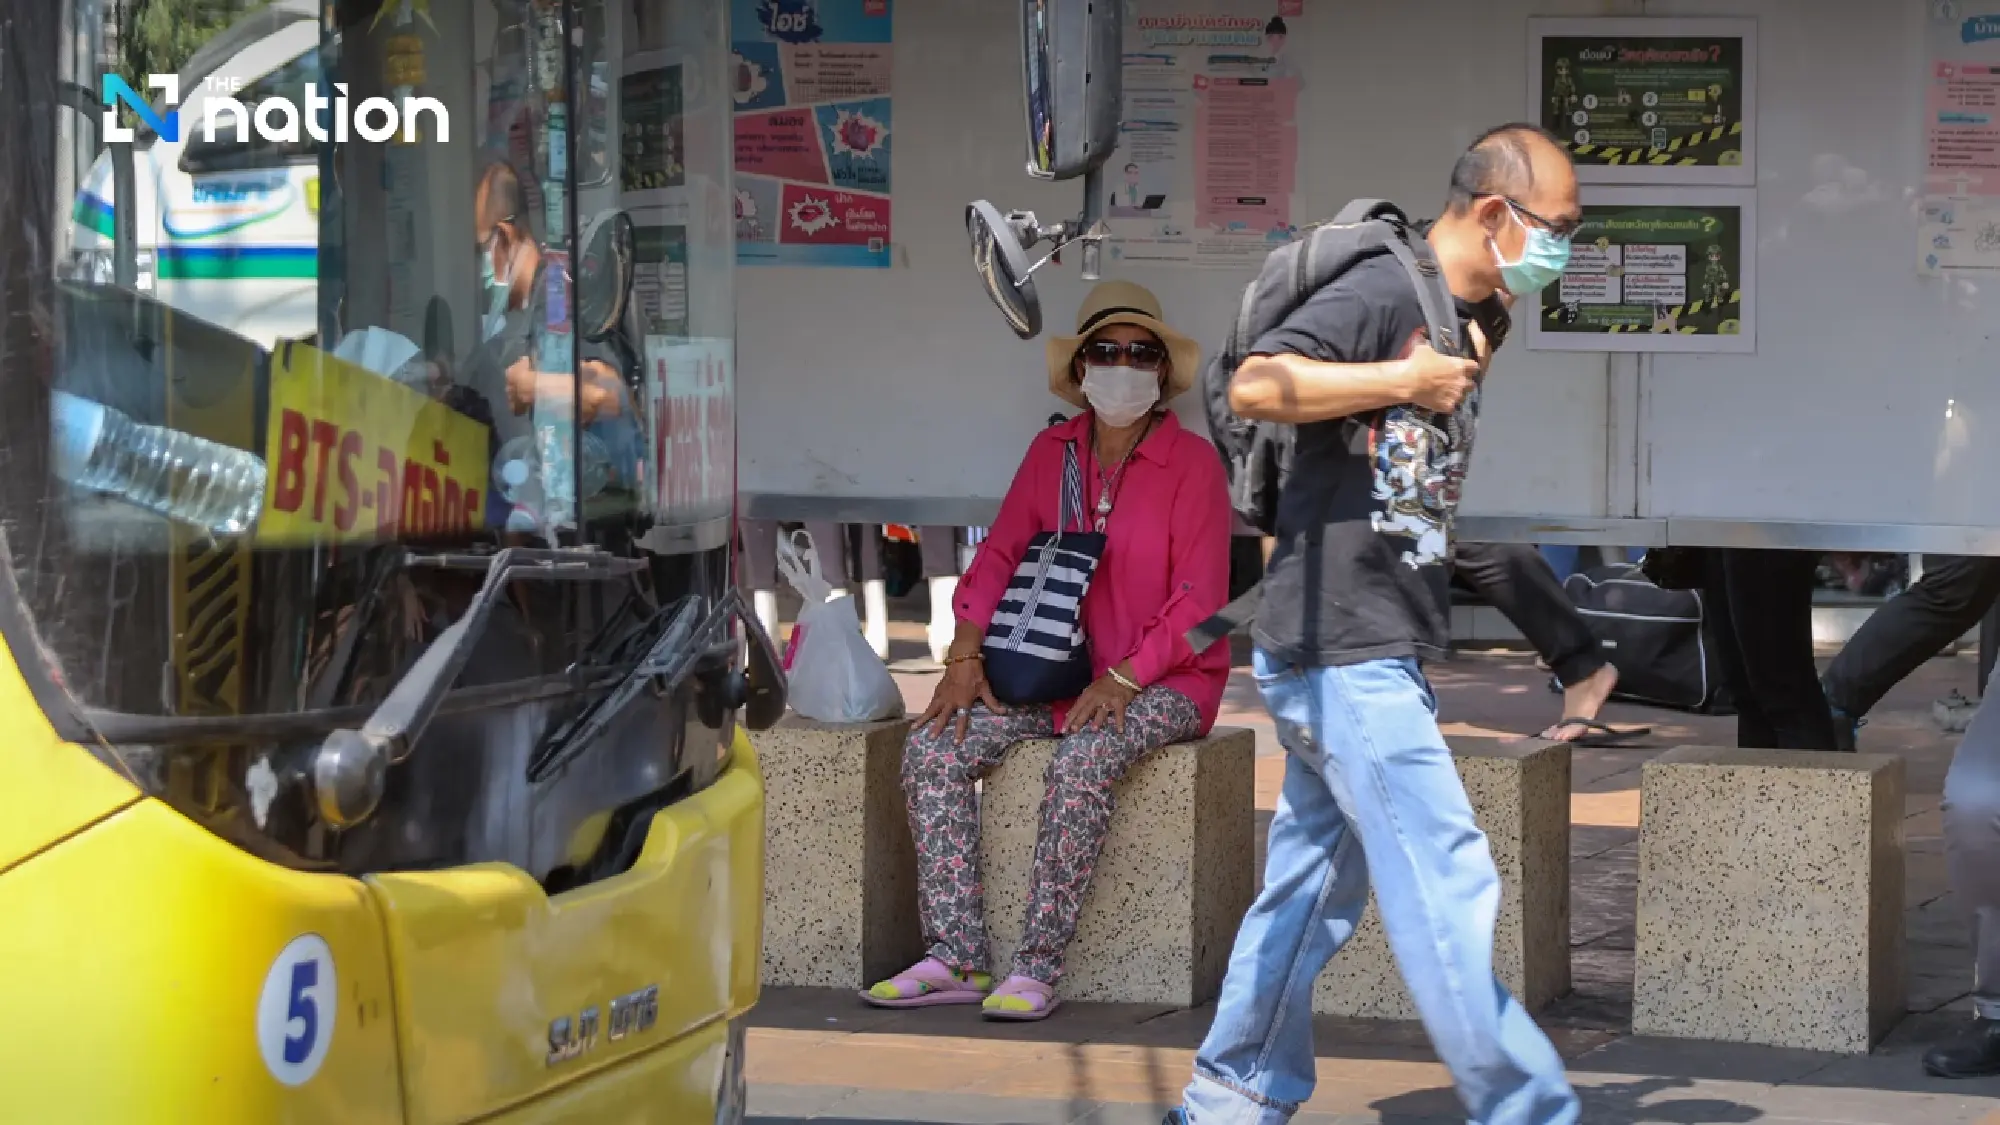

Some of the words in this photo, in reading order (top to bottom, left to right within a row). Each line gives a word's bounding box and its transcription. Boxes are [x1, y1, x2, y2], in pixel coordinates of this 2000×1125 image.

[273, 407, 480, 538] BTS-จตจักร
[282, 958, 319, 1064] 5
